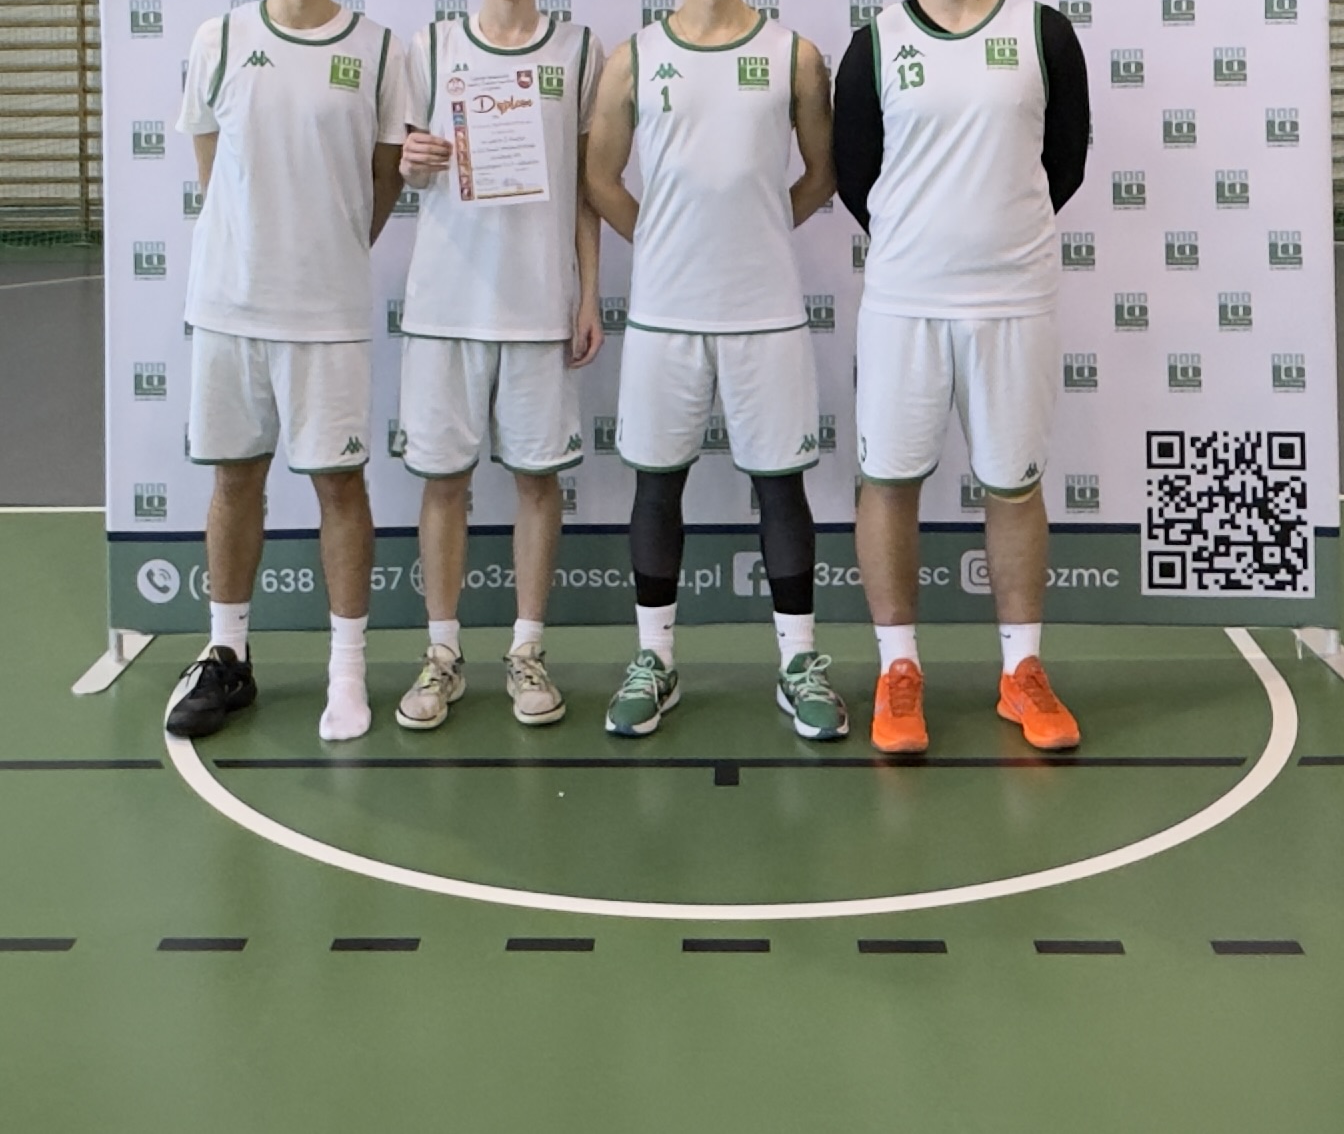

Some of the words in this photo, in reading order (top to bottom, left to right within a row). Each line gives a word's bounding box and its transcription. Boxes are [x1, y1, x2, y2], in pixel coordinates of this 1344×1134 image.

[897, 62, 925, 91] 13
[660, 85, 672, 113] 1
[261, 568, 315, 594] 638
